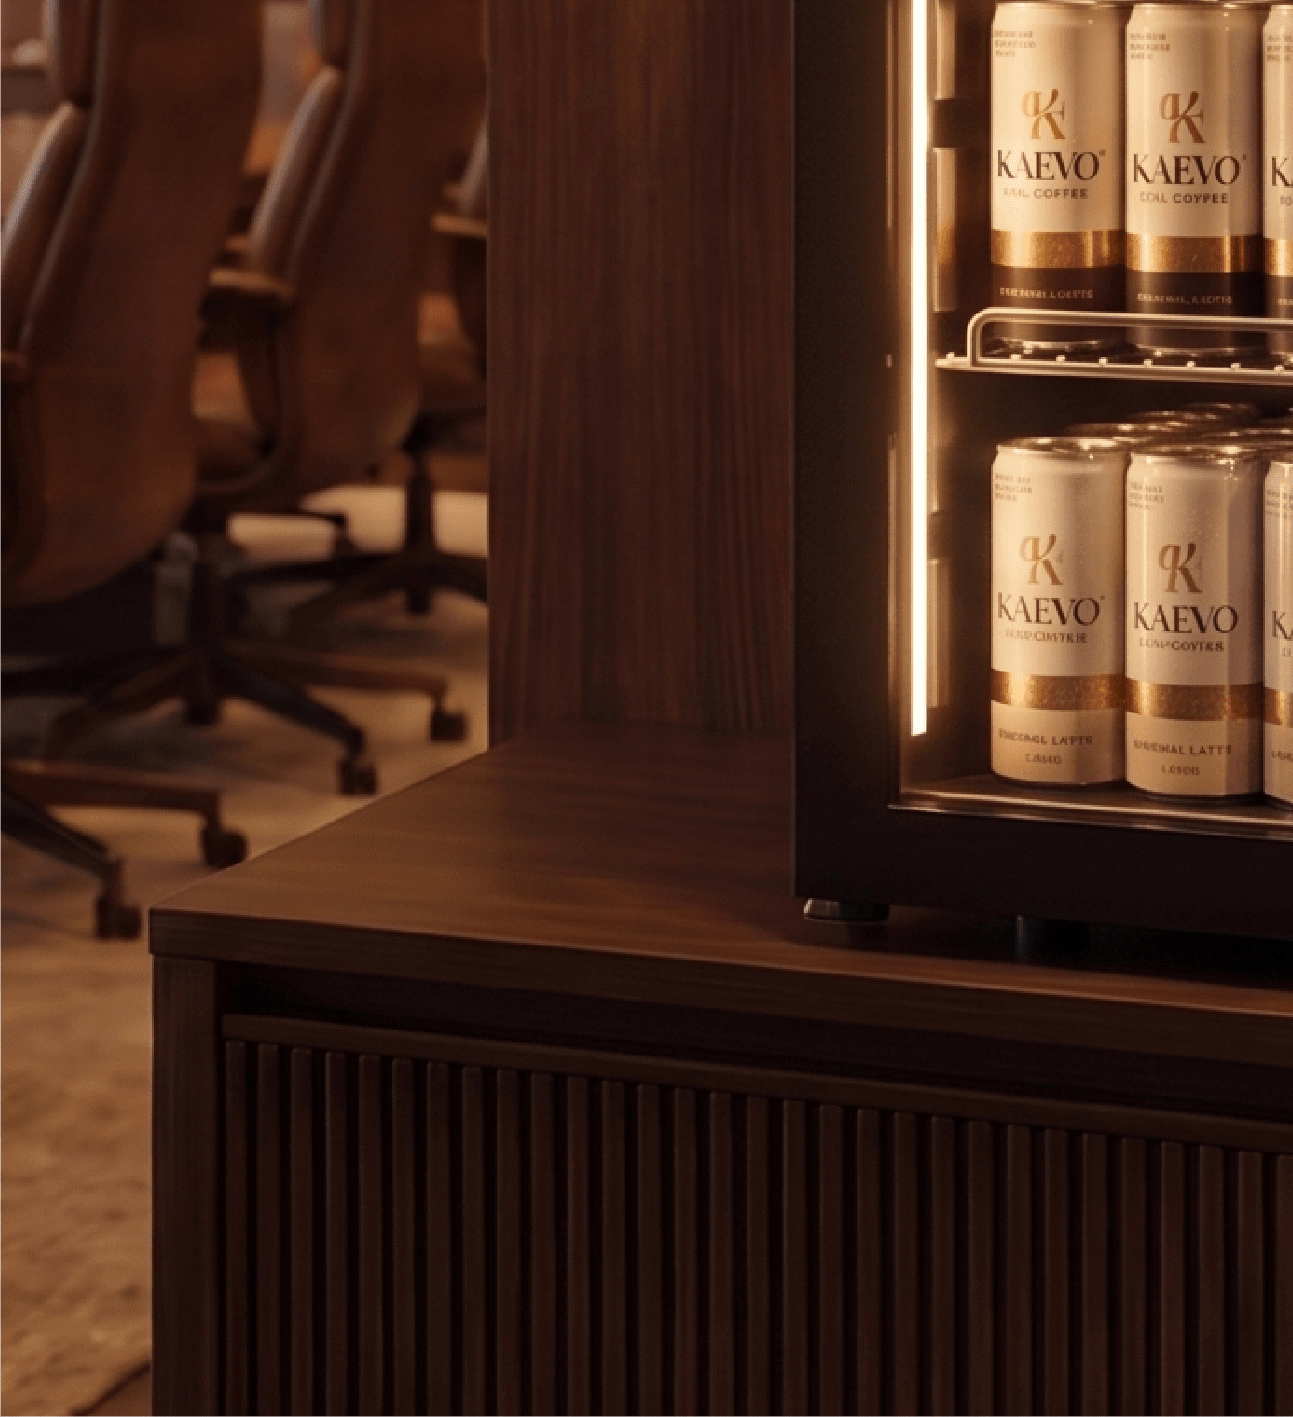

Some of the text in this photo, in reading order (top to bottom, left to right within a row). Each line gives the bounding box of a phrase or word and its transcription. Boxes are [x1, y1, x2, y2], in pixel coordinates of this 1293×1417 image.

[997, 149, 1100, 180] KAEVO
[1133, 153, 1240, 185] KAEVO
[997, 592, 1100, 626] KAEVO
[1133, 601, 1239, 634] KAEVO
